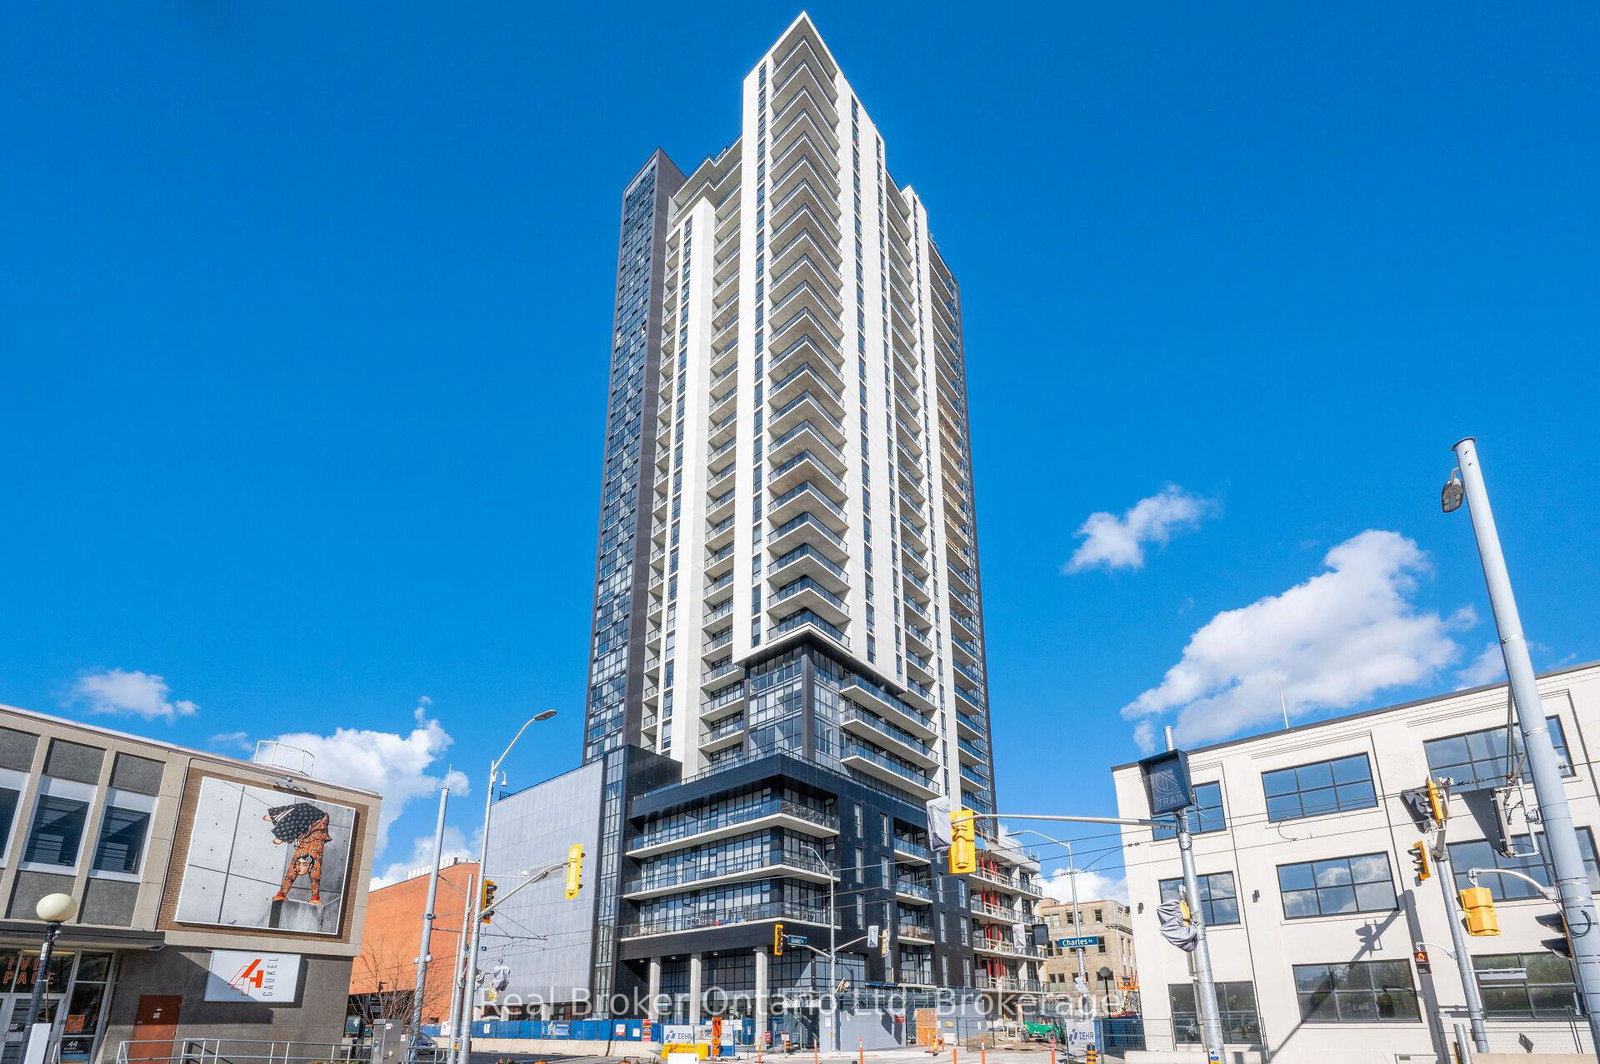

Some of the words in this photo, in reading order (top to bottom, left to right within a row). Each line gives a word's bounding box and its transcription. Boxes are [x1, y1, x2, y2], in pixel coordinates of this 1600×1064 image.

[1062, 939, 1088, 947] Charles
[263, 958, 279, 996] GAUKEL
[1078, 1031, 1094, 1040] ZEHR
